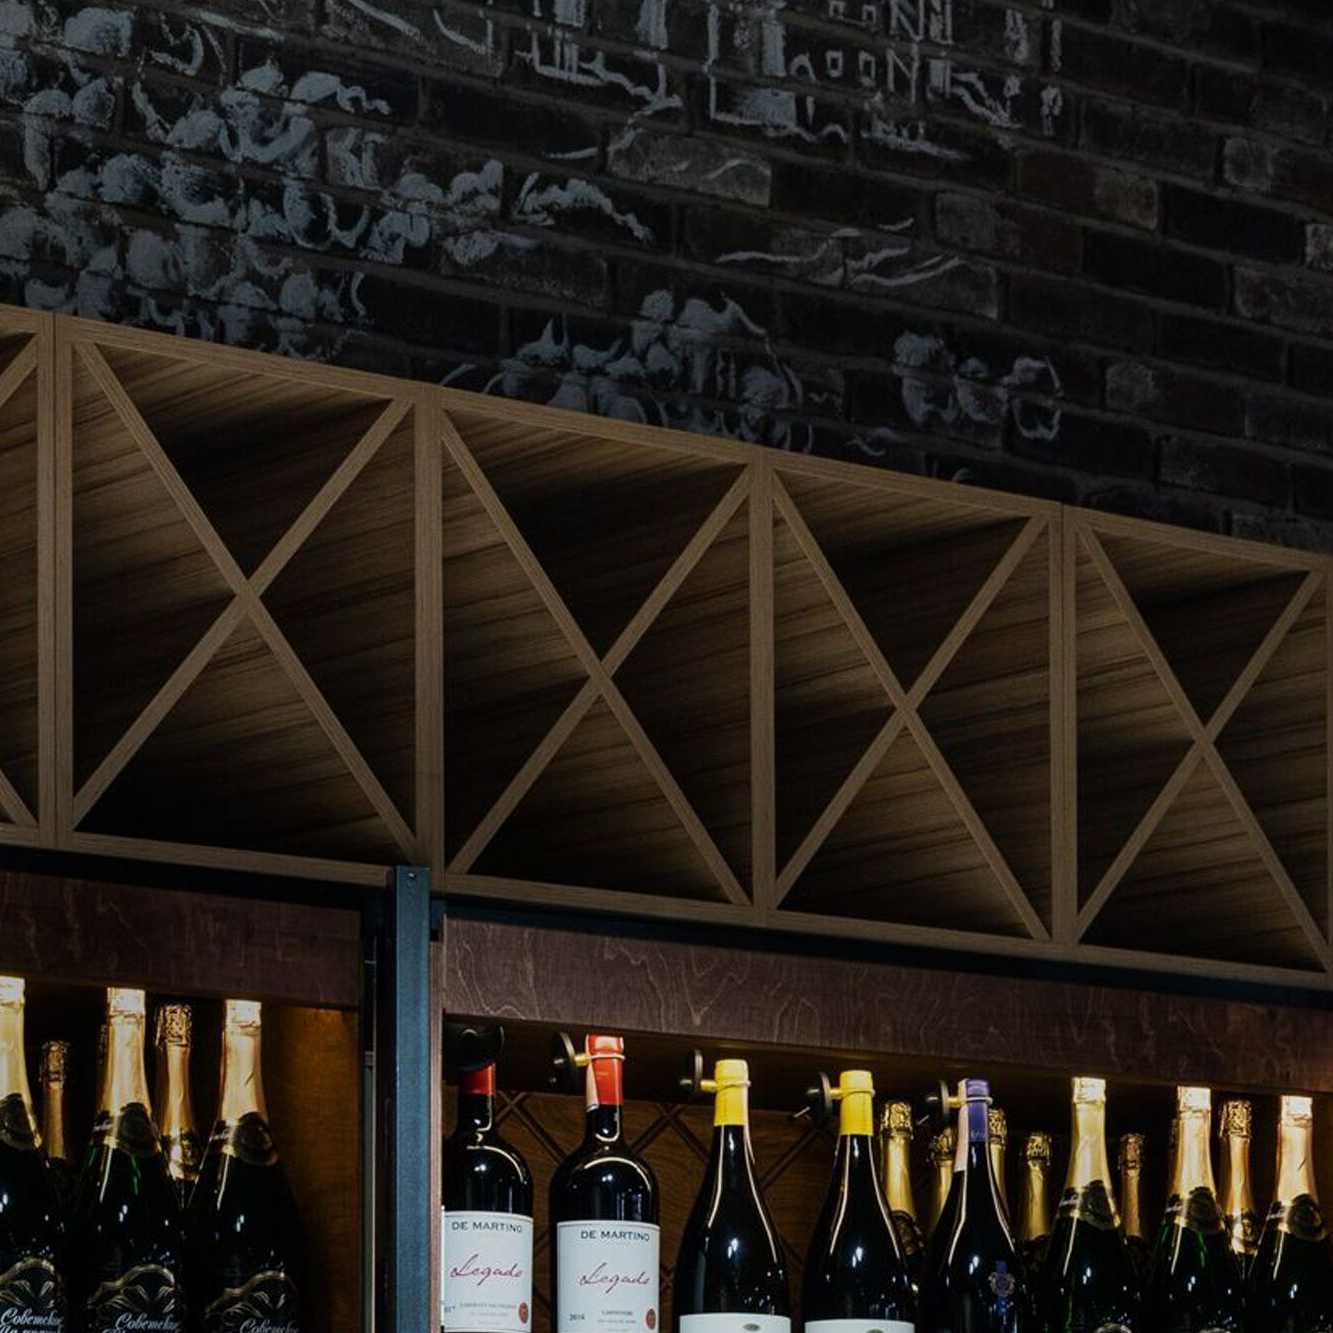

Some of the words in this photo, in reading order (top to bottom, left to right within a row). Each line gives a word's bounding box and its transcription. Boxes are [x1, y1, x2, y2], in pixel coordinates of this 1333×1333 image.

[452, 1221, 469, 1231] DE
[472, 1221, 523, 1234] MARTINO
[581, 1230, 597, 1239] DE
[600, 1230, 650, 1242] MARTINO
[450, 1253, 523, 1286] Legado
[579, 1262, 650, 1294] Legado
